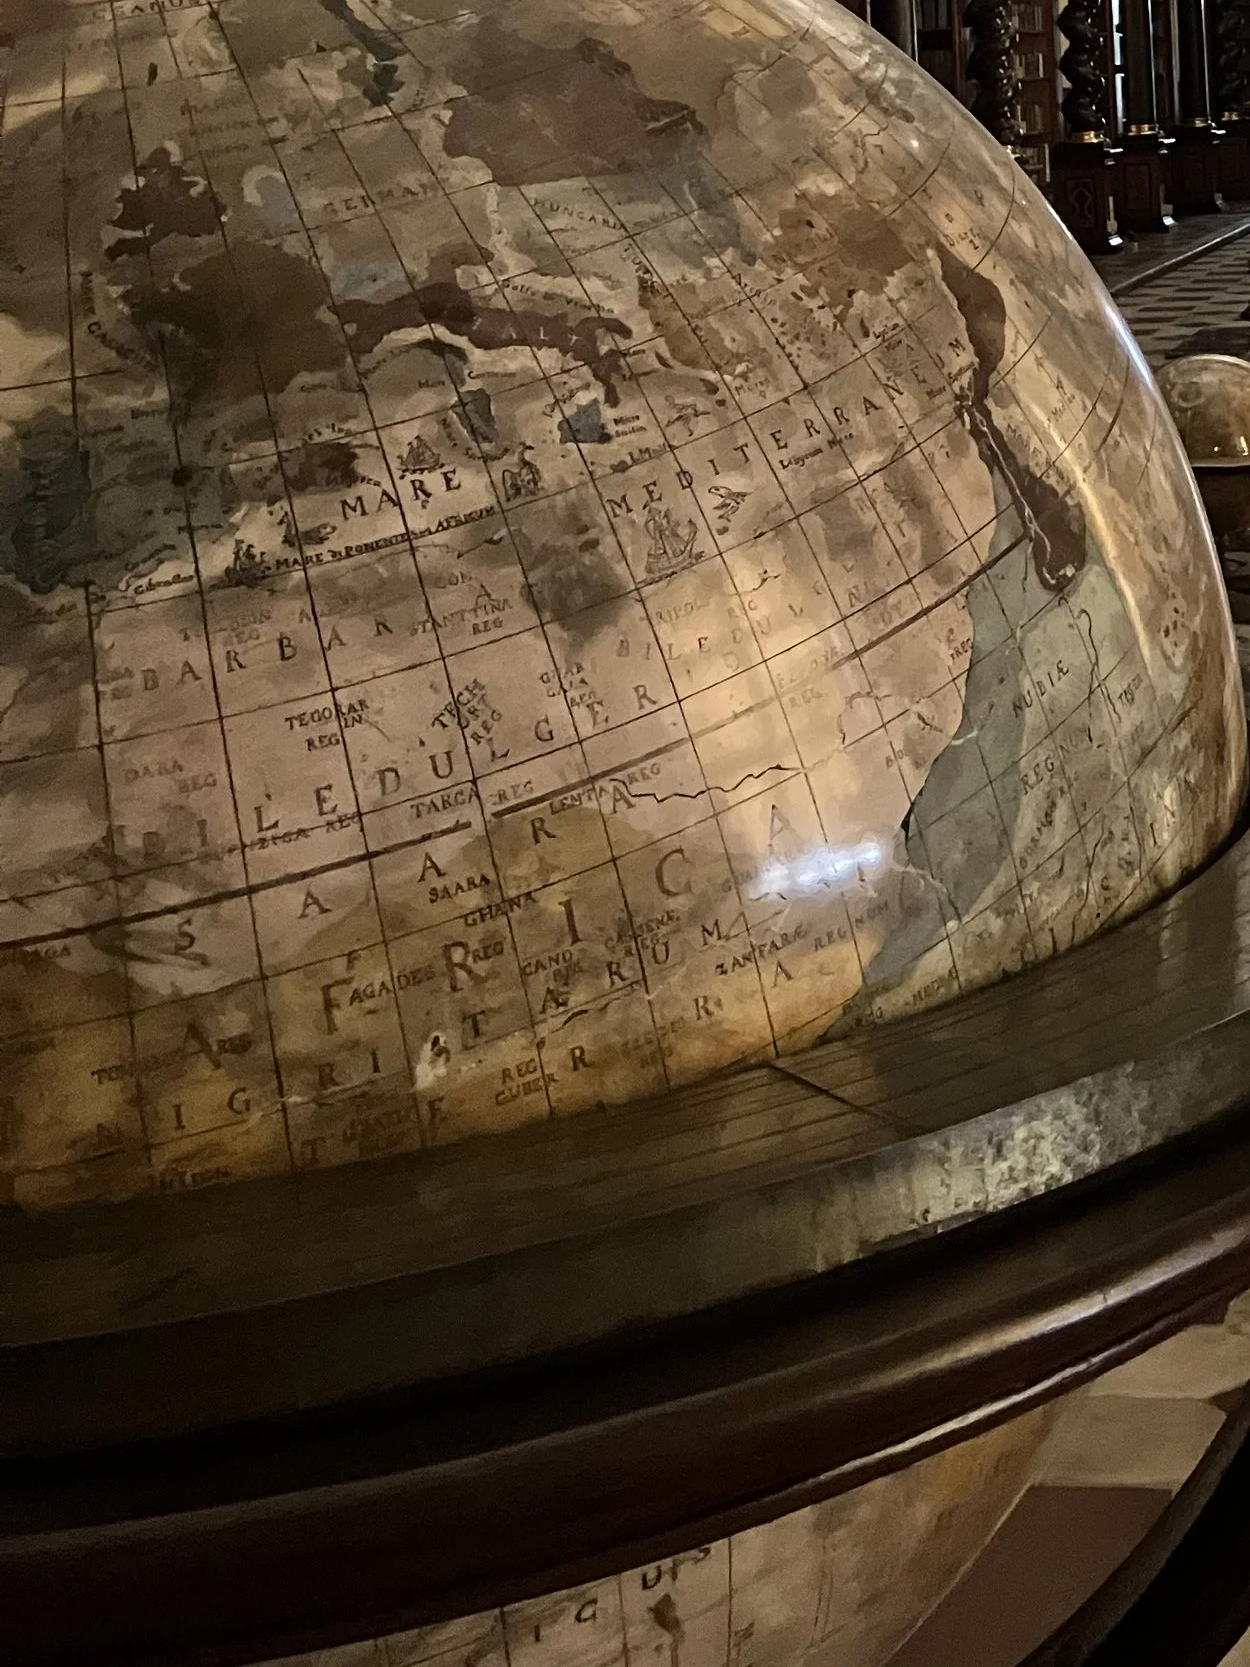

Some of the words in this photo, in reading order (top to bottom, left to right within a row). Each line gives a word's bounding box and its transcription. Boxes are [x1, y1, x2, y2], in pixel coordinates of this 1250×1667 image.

[339, 468, 461, 521] MARE
[275, 550, 325, 572] MARE
[305, 733, 342, 752] REG
[626, 761, 662, 786] REG
[410, 786, 480, 820] TARGA
